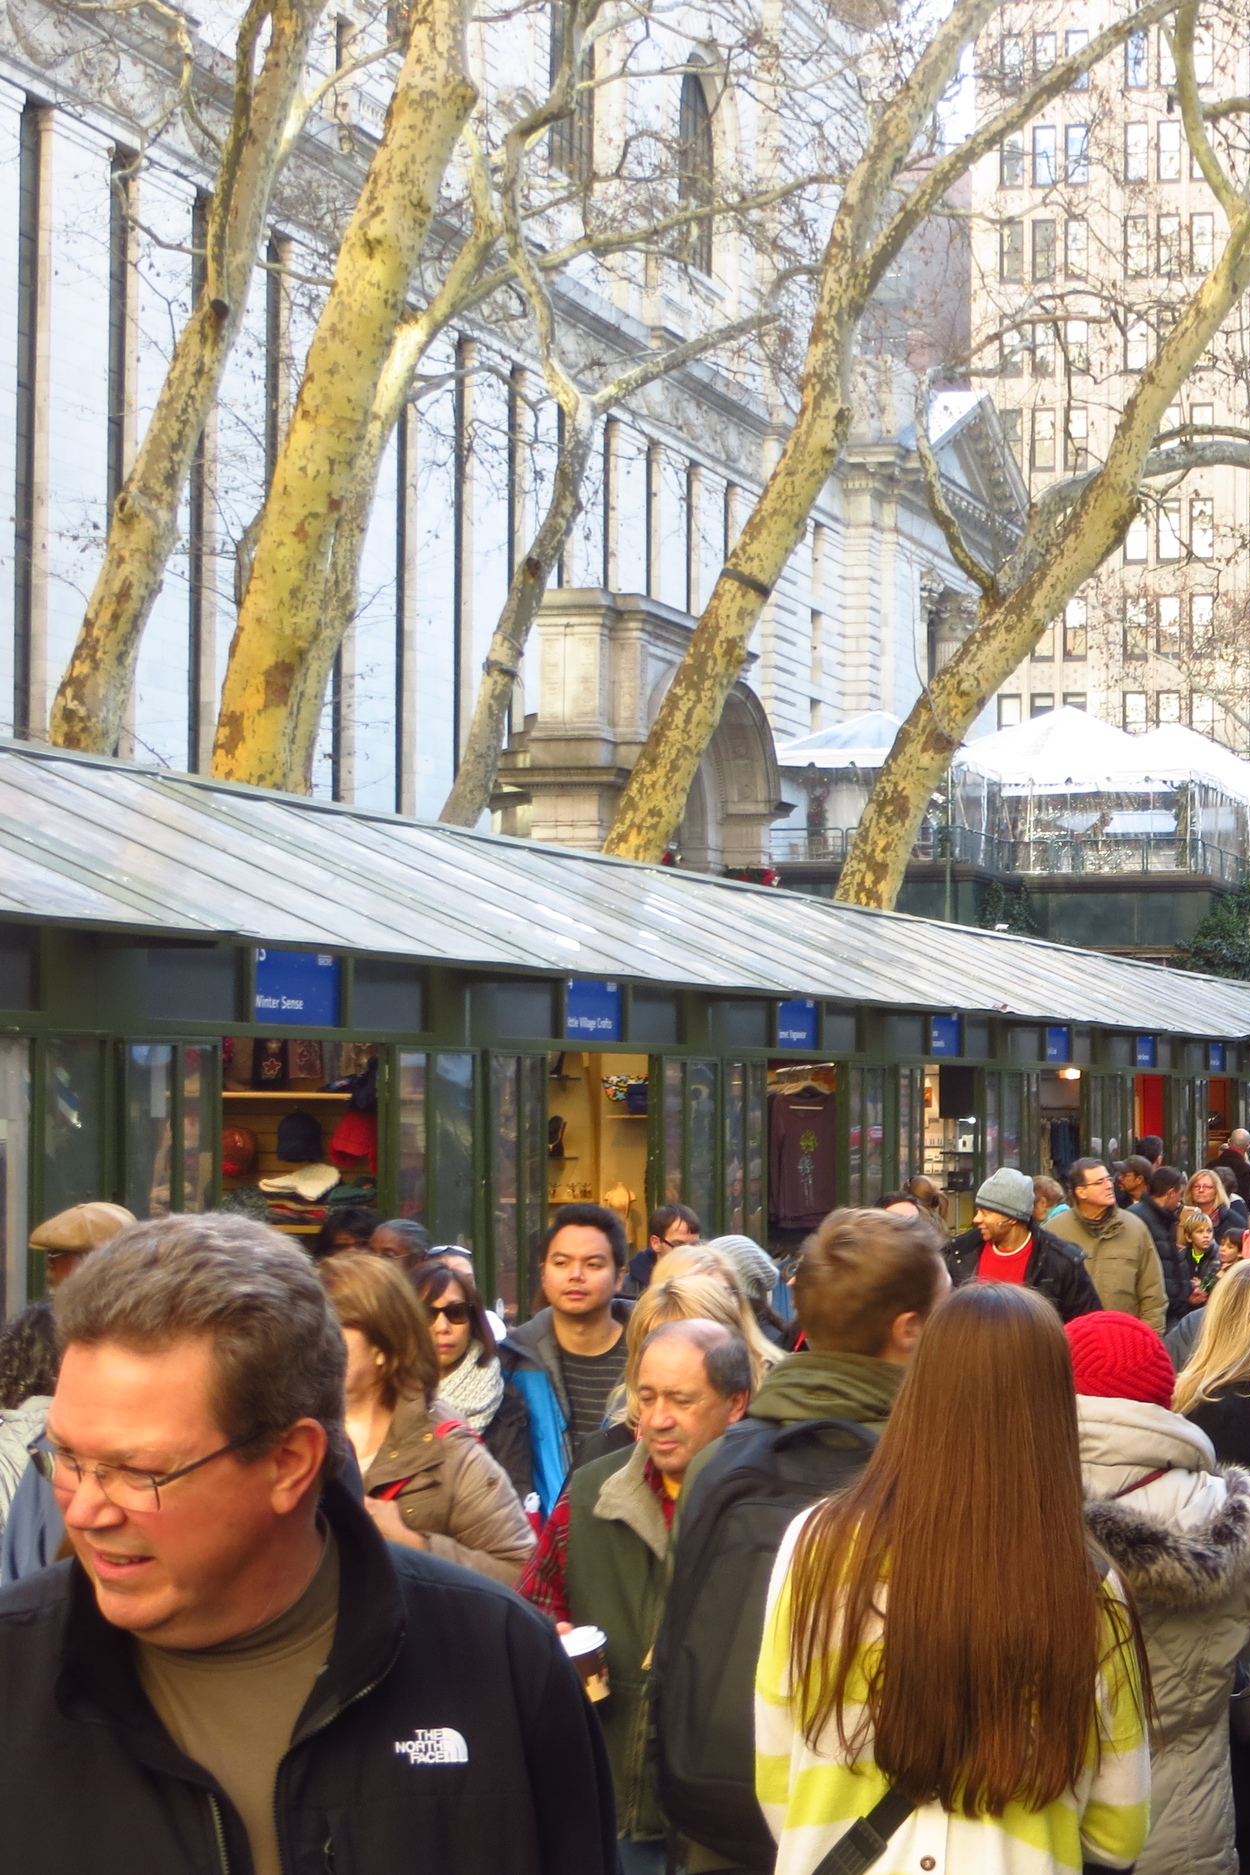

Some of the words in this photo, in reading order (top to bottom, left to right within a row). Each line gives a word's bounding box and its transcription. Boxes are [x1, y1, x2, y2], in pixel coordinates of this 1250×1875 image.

[281, 995, 304, 1010] Sense
[414, 1729, 442, 1740] THE
[394, 1740, 443, 1754] NORTH
[410, 1751, 446, 1765] FACE
